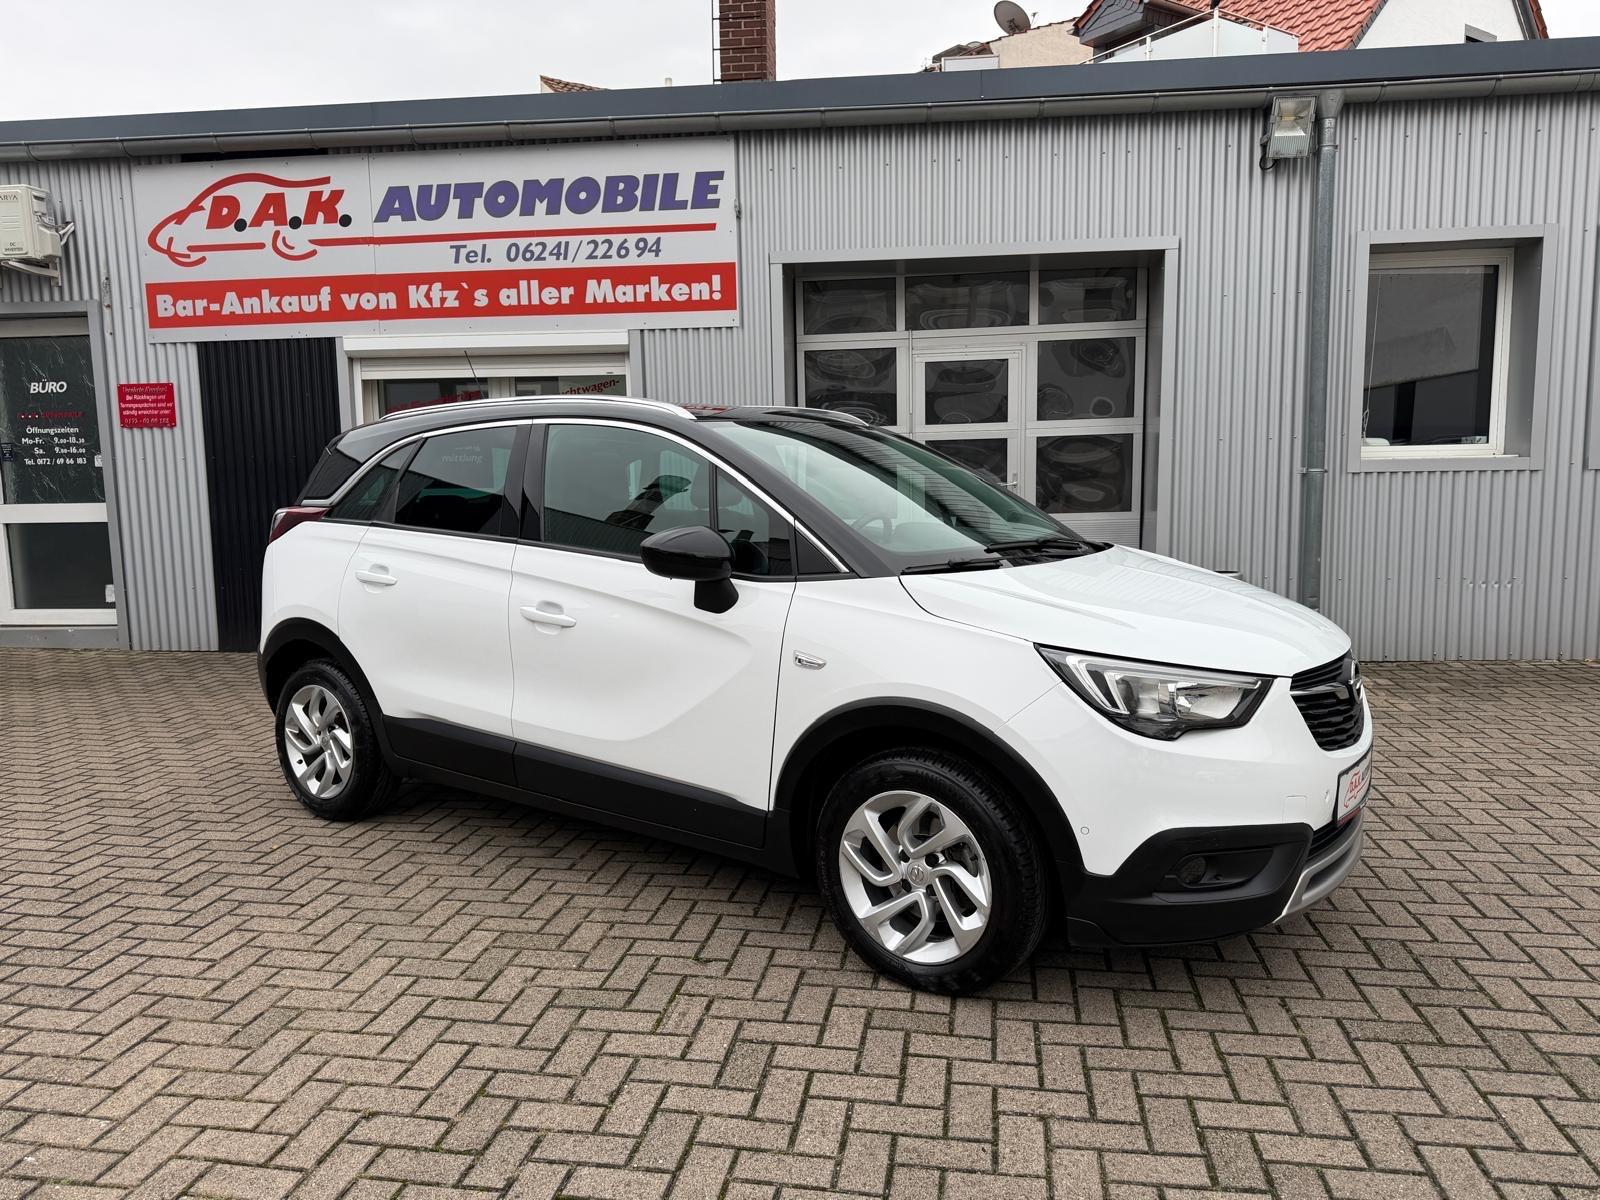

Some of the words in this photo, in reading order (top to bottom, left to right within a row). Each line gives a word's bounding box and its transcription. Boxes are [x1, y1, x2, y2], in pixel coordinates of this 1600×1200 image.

[206, 189, 352, 232] D.A.K.
[373, 170, 725, 223] AUTOMOBILE
[450, 243, 492, 264] Tel.
[155, 286, 332, 318] Bar-Ankauf
[340, 291, 397, 311] von
[499, 279, 575, 307] aller
[585, 274, 722, 304] Marken!
[30, 379, 68, 394] BÜRO
[561, 379, 620, 395] chtwagen-
[26, 426, 79, 435] Öffnungszeiten
[22, 437, 45, 445] Mo-Fr.
[76, 457, 87, 465] 183
